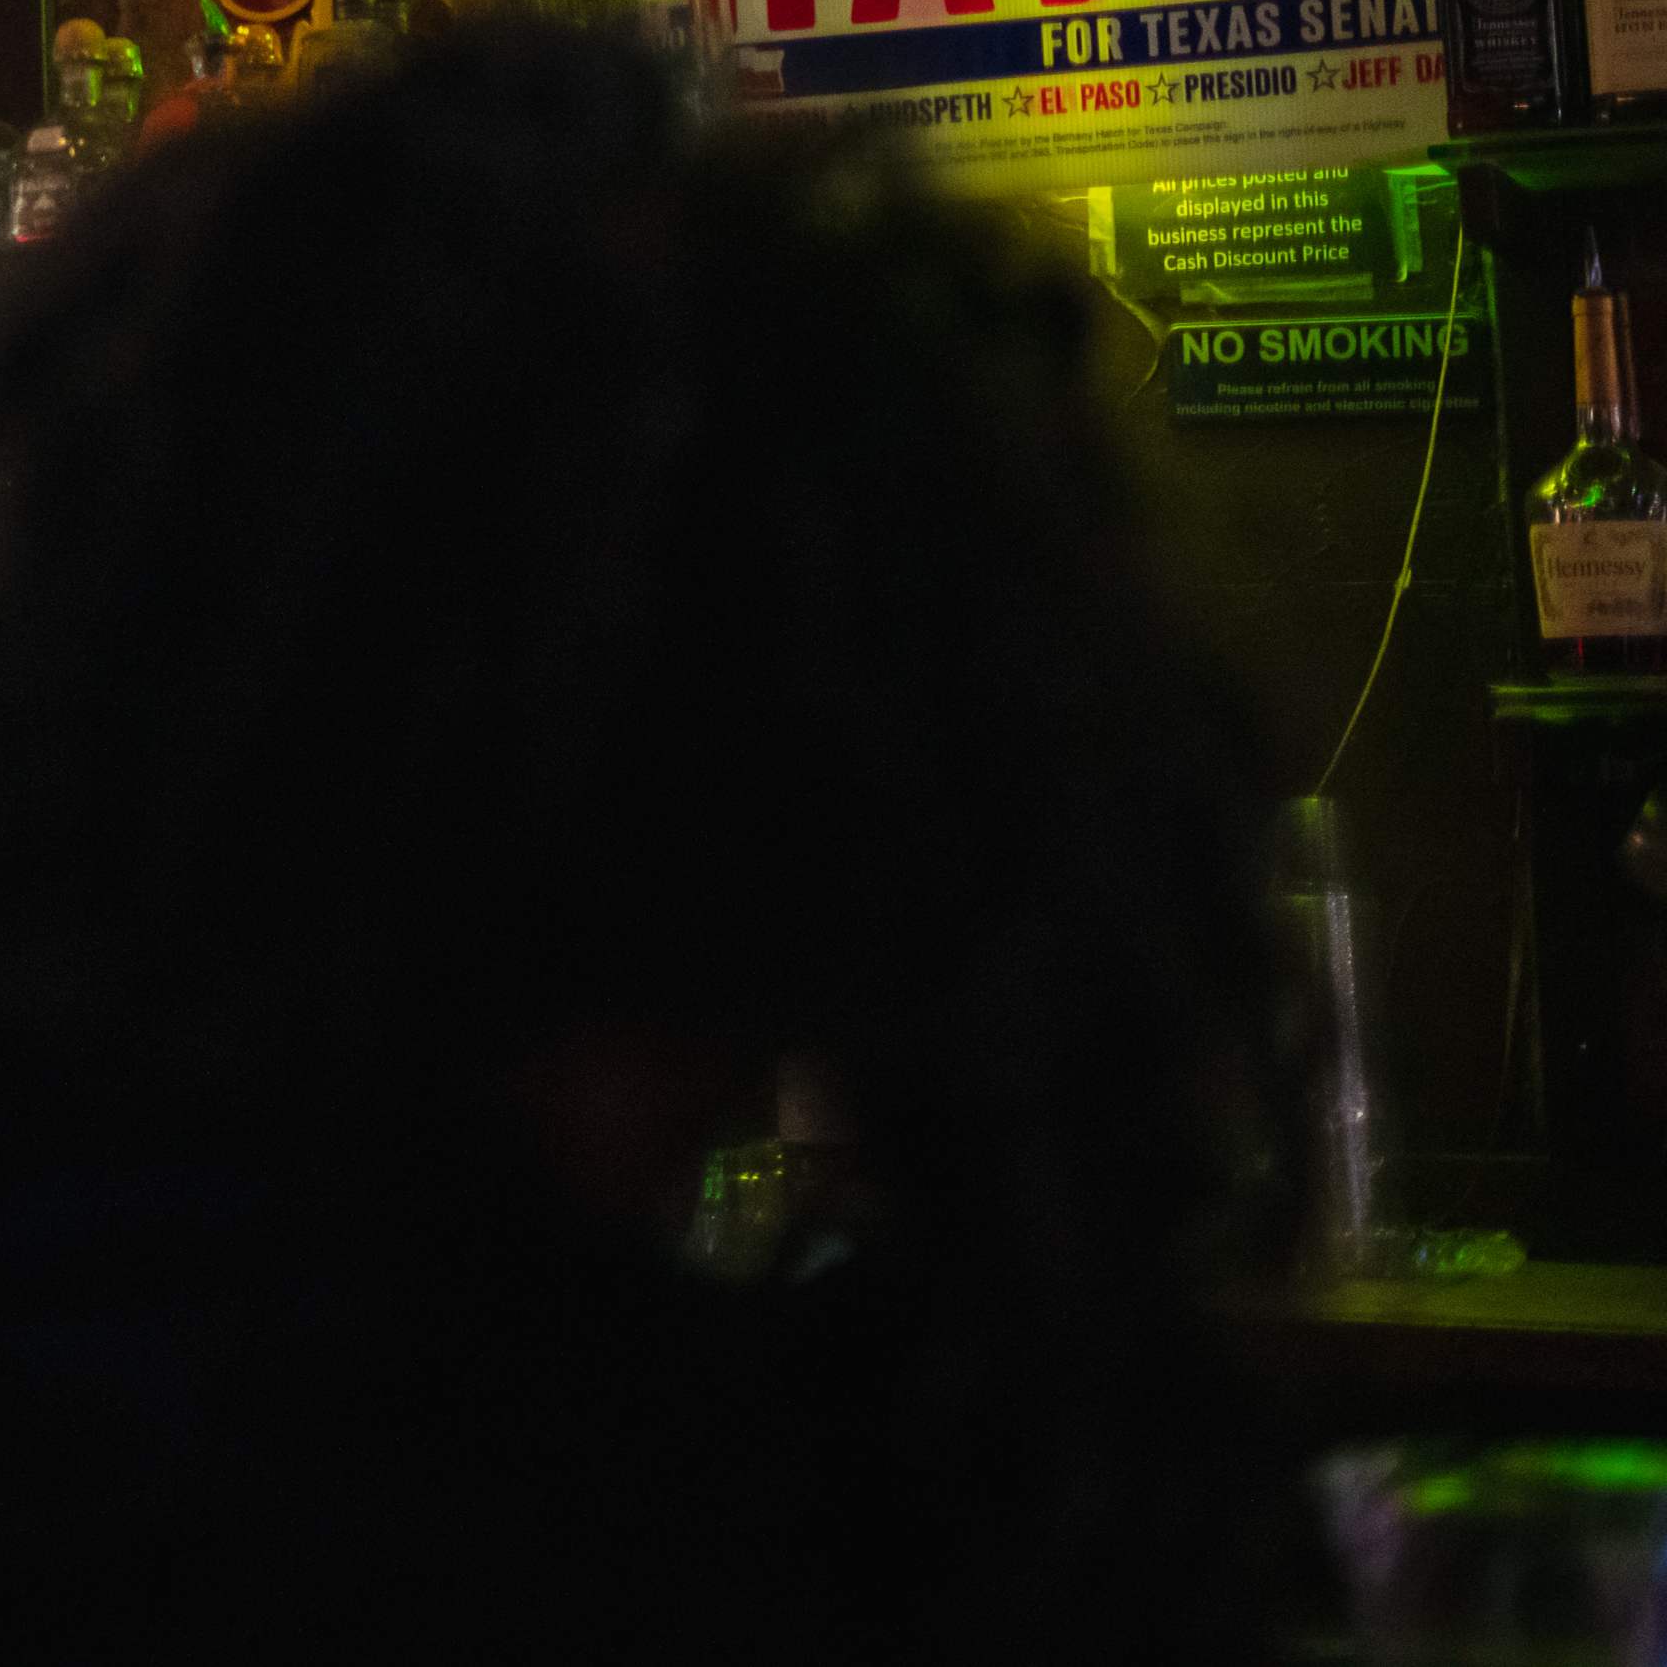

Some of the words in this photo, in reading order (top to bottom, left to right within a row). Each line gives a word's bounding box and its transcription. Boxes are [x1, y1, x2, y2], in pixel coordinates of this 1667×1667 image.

[1041, 16, 1124, 71] FOR
[1140, 3, 1282, 57] TEXAS
[1040, 85, 1066, 115] EL
[1080, 79, 1141, 111] PASO
[1184, 65, 1298, 103] PRESIDIO
[1342, 56, 1402, 91] JEFF
[1056, 141, 1125, 156] Transportation
[1173, 135, 1200, 147] place
[1223, 131, 1245, 144] sign
[1259, 127, 1276, 139] the
[1145, 124, 1173, 135] Texas
[1175, 194, 1265, 220] displayed
[1271, 192, 1288, 211] in
[1294, 190, 1329, 210] this
[1147, 224, 1228, 249] business
[1232, 218, 1327, 245] represent
[1330, 214, 1363, 234] the
[1163, 251, 1208, 272] Cash
[1213, 246, 1297, 270] Discount
[1302, 244, 1350, 262] Price
[1181, 330, 1245, 367] NO
[1258, 322, 1470, 365] SMOKING
[1217, 382, 1264, 396] Please
[1267, 381, 1313, 395] refrain
[1316, 380, 1351, 394] from
[1353, 378, 1371, 392] all
[1374, 378, 1436, 394] smoking
[1176, 401, 1241, 417] including
[1244, 400, 1301, 413] nicotine
[1304, 399, 1332, 412] and
[1335, 397, 1406, 412] electronic
